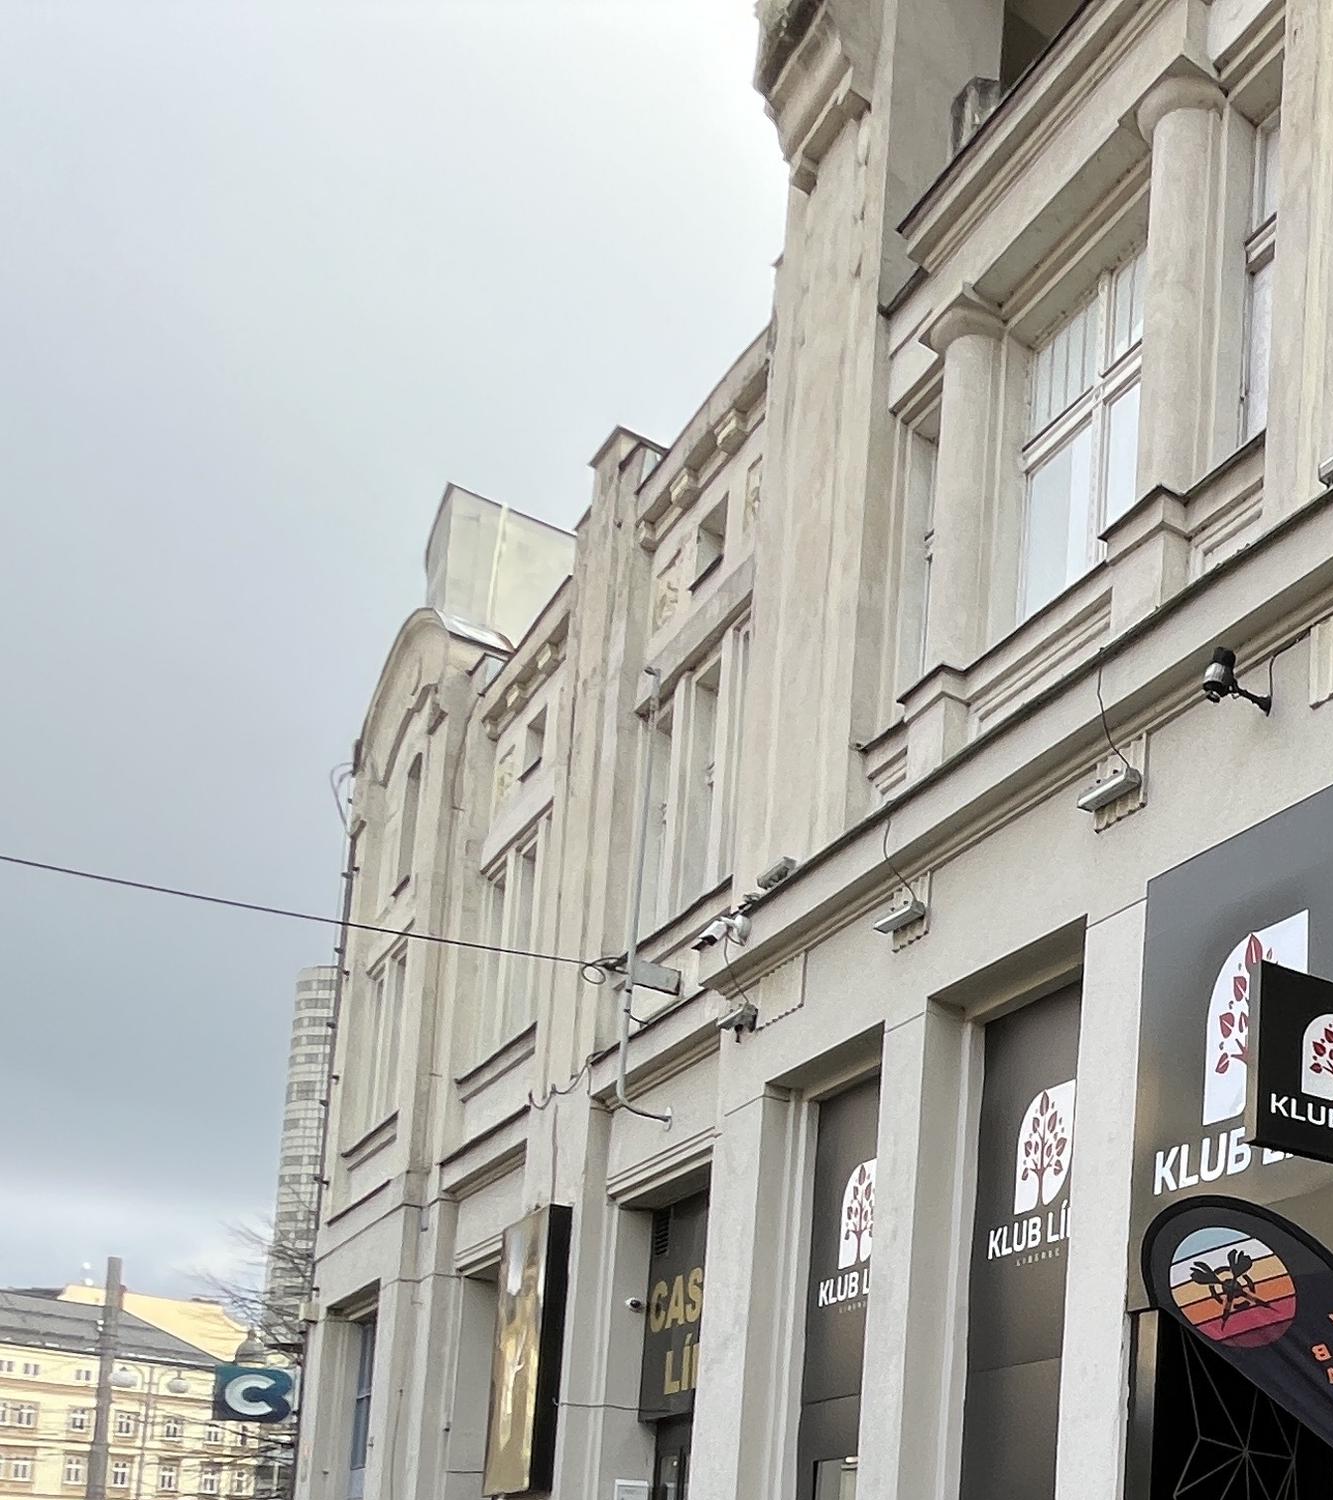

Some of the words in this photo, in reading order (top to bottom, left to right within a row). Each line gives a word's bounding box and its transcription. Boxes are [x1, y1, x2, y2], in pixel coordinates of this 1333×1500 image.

[1153, 1126, 1252, 1196] KLUB
[986, 1215, 1042, 1260] KLUB
[818, 1270, 860, 1308] KLUB
